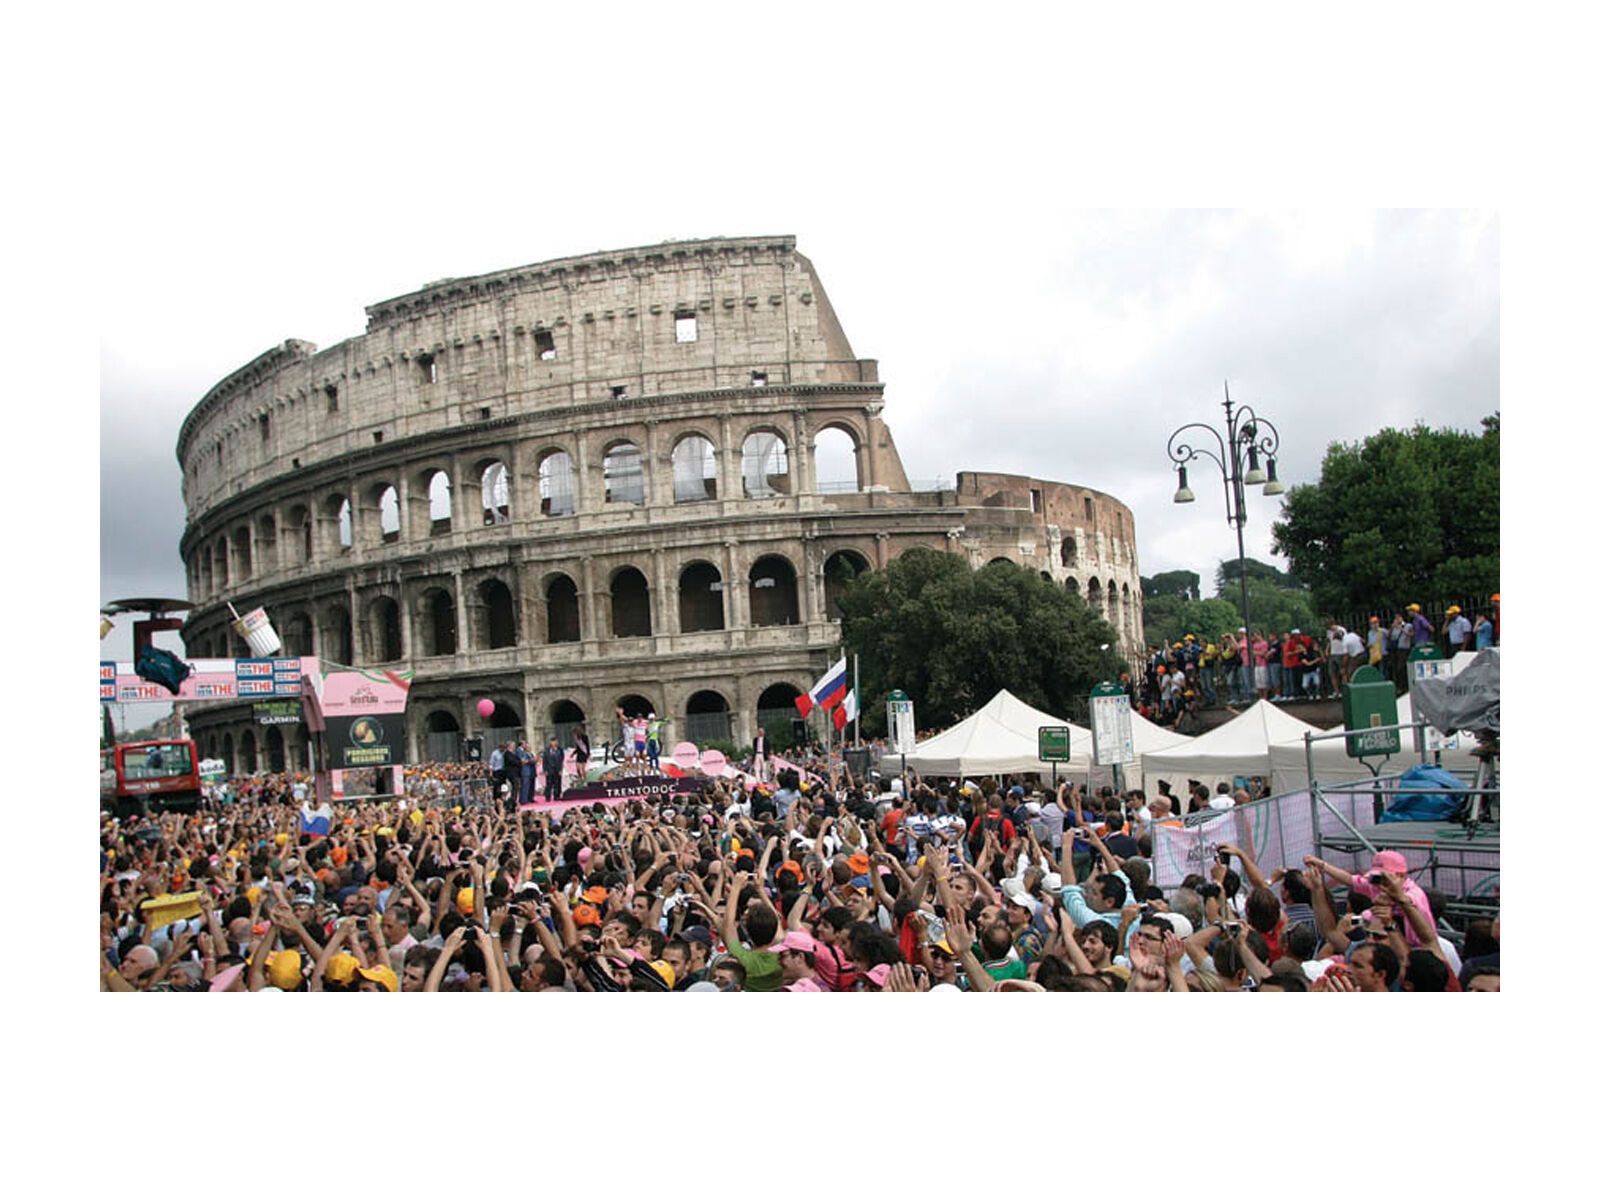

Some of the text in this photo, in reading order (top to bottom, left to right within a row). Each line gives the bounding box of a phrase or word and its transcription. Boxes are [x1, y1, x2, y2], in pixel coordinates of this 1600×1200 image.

[100, 667, 113, 678] HE
[100, 686, 113, 697] HE
[1446, 684, 1486, 697] PHIPS
[260, 716, 300, 725] GARMIN
[606, 784, 677, 797] TRENTODOC
